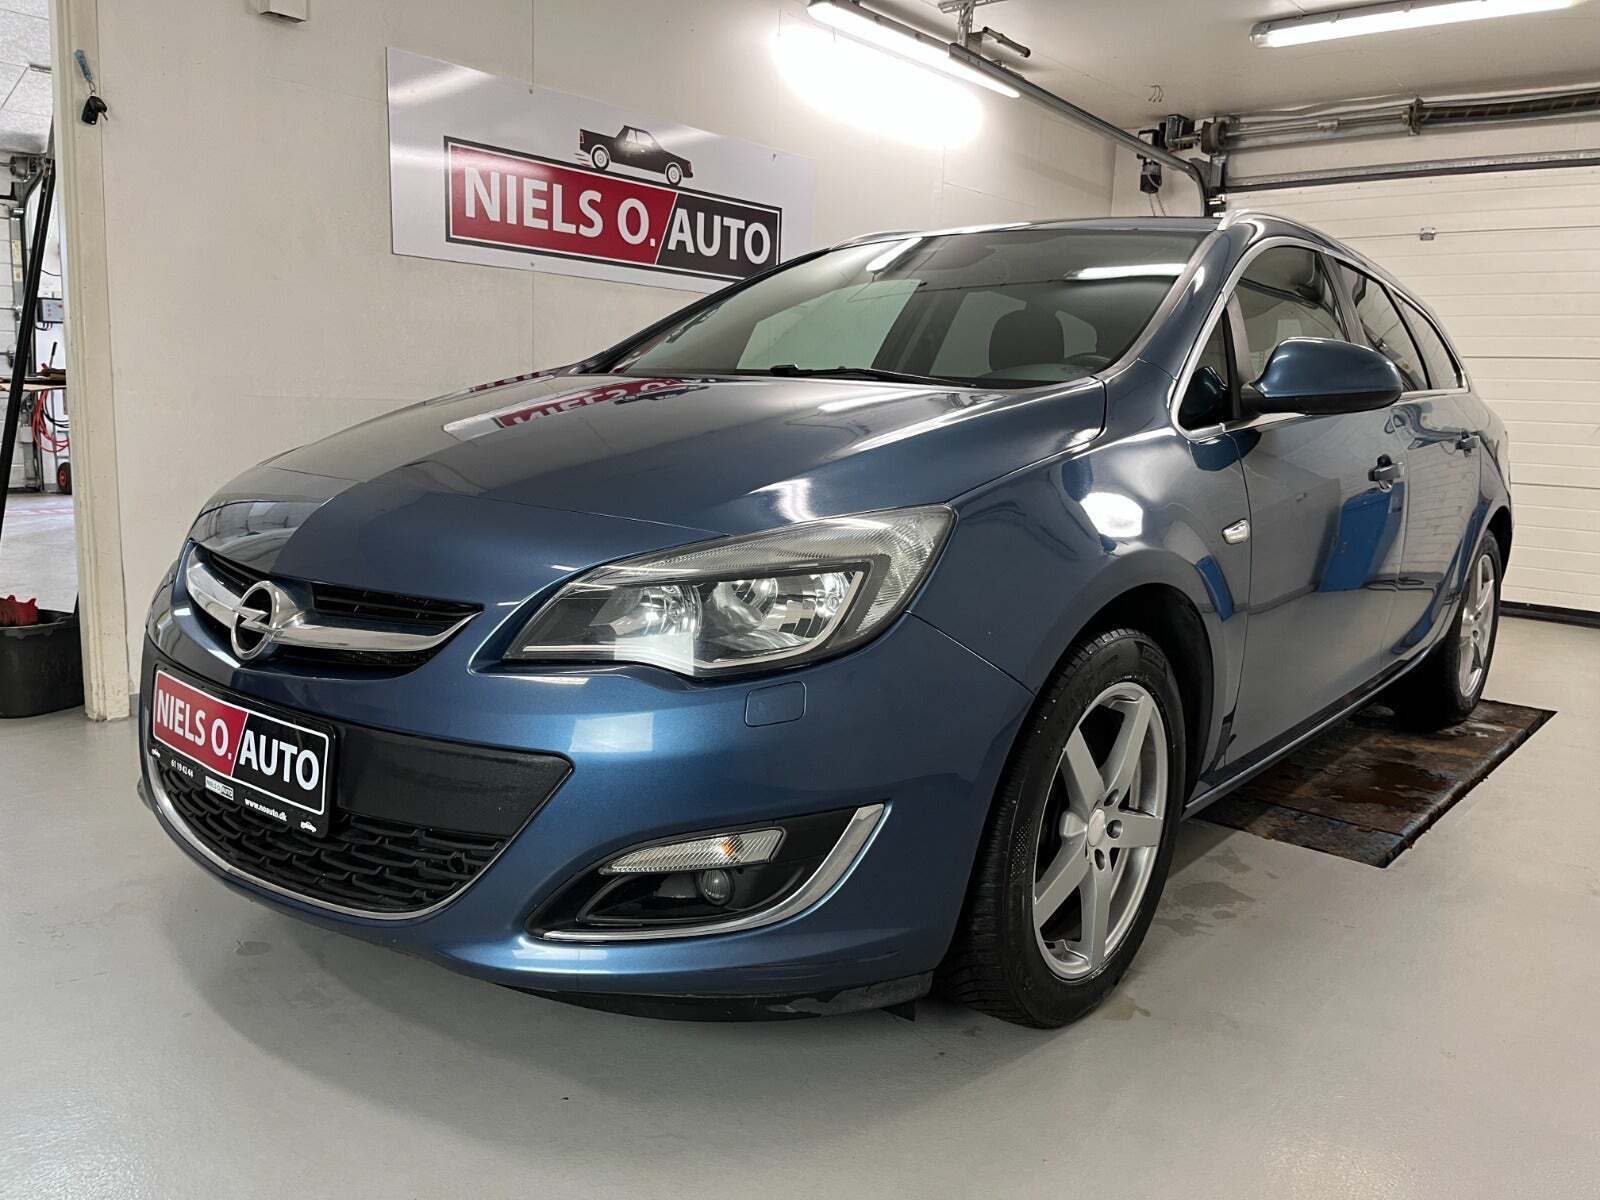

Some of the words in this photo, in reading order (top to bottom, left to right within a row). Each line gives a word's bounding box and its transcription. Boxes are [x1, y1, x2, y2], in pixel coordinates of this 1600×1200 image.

[464, 167, 604, 238] NIELS
[617, 197, 657, 247] O.
[667, 207, 771, 265] AUTO
[156, 689, 206, 747] NIELS
[211, 718, 232, 760] O.
[239, 729, 320, 791] AUTO
